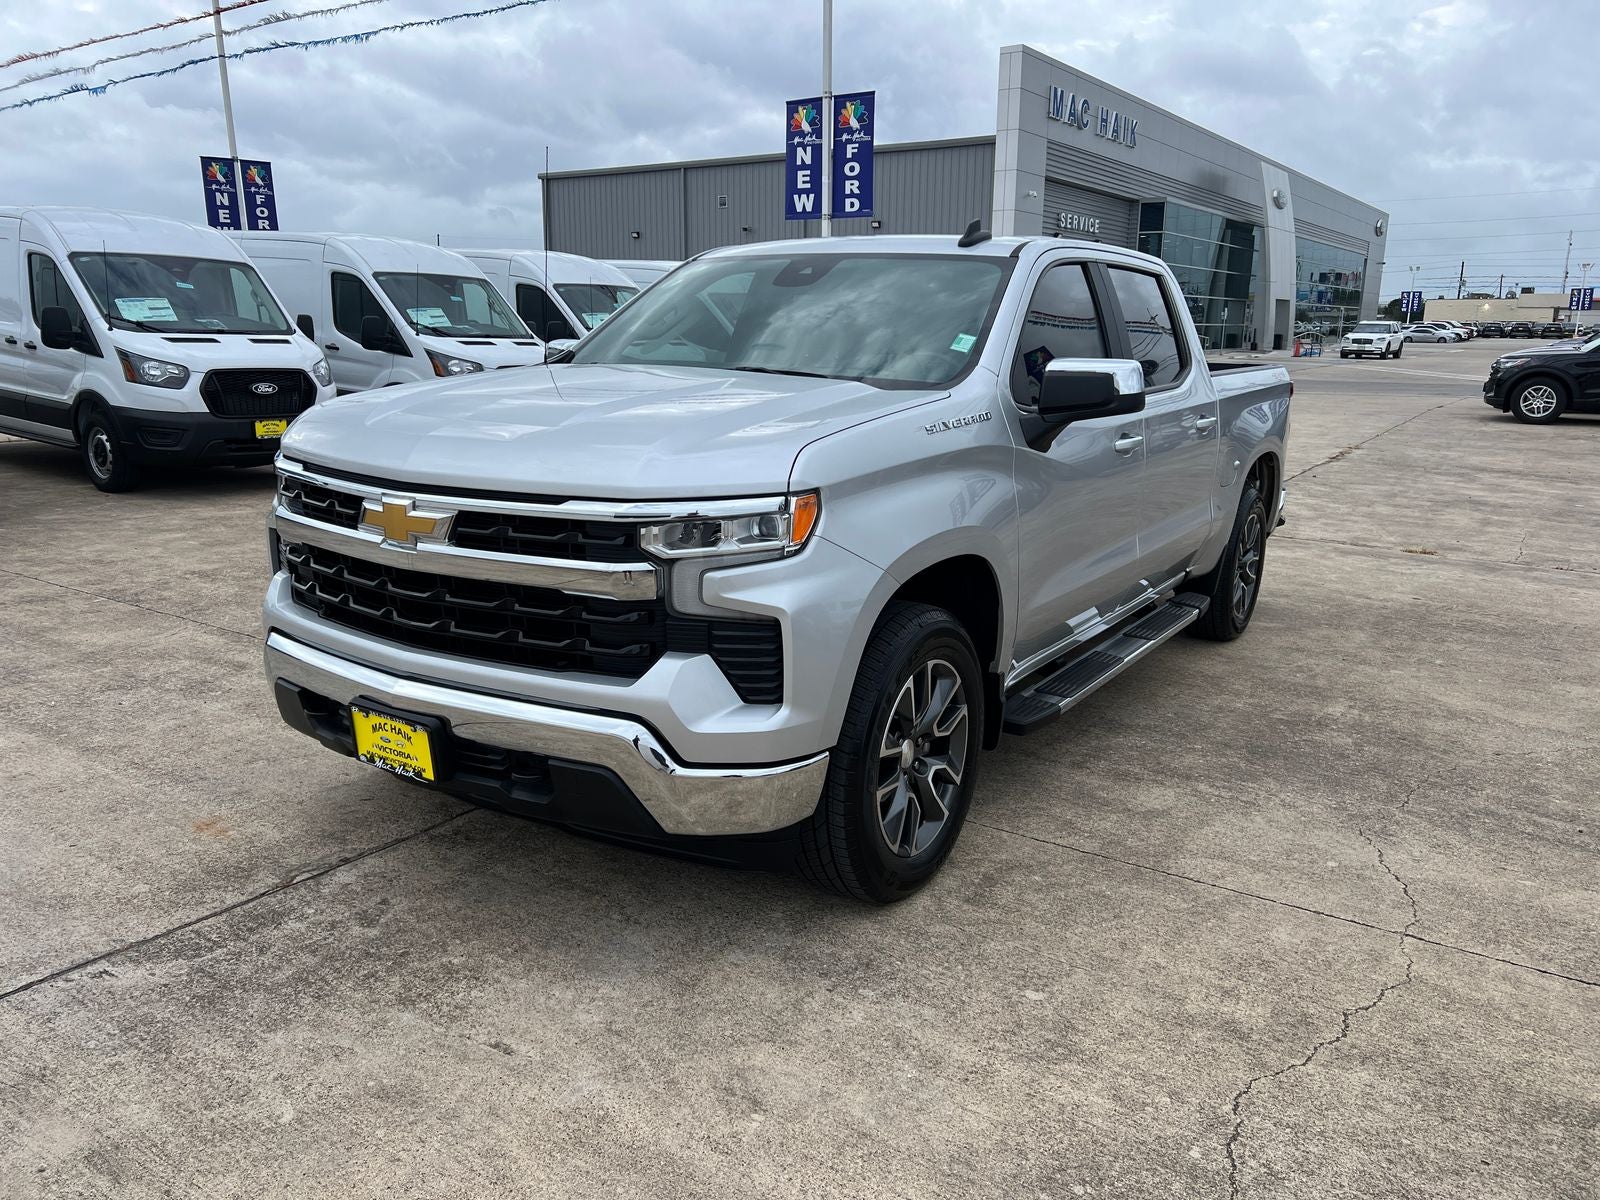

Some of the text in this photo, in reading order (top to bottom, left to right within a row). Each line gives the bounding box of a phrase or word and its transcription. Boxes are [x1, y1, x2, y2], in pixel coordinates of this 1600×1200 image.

[1049, 85, 1138, 148] MAC HAIK
[793, 146, 814, 212] NEW
[844, 143, 860, 212] FORD
[255, 194, 270, 230] FOR
[1060, 212, 1100, 233] SERVICE
[925, 410, 992, 435] SILVERADO
[371, 722, 413, 746] MAC HAIK
[374, 759, 394, 772] Mac
